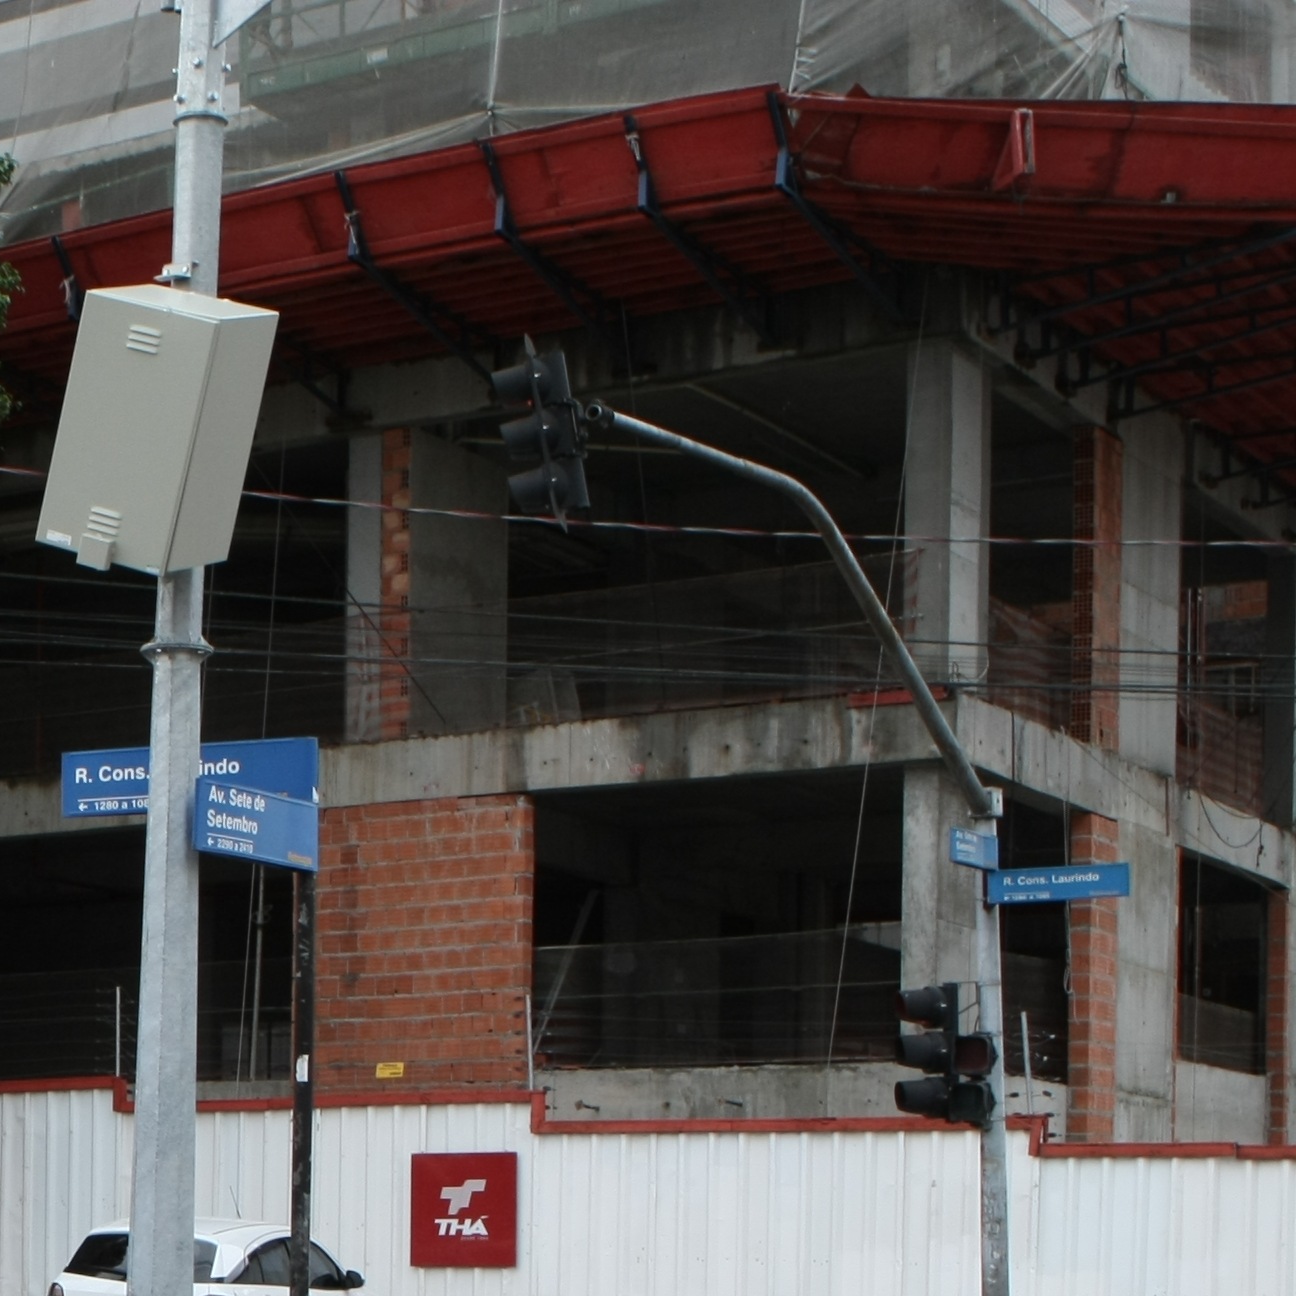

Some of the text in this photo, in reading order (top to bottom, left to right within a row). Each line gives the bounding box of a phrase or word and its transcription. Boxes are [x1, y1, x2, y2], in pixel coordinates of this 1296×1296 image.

[75, 758, 240, 784] R. Cons. indo
[208, 785, 226, 804] Av.
[229, 788, 252, 810] Sete
[254, 794, 265, 812] de
[206, 809, 258, 835] Setembro
[1017, 875, 1049, 886] Cons.
[1052, 871, 1100, 884] Laurindo
[434, 1215, 489, 1236] THÁ
